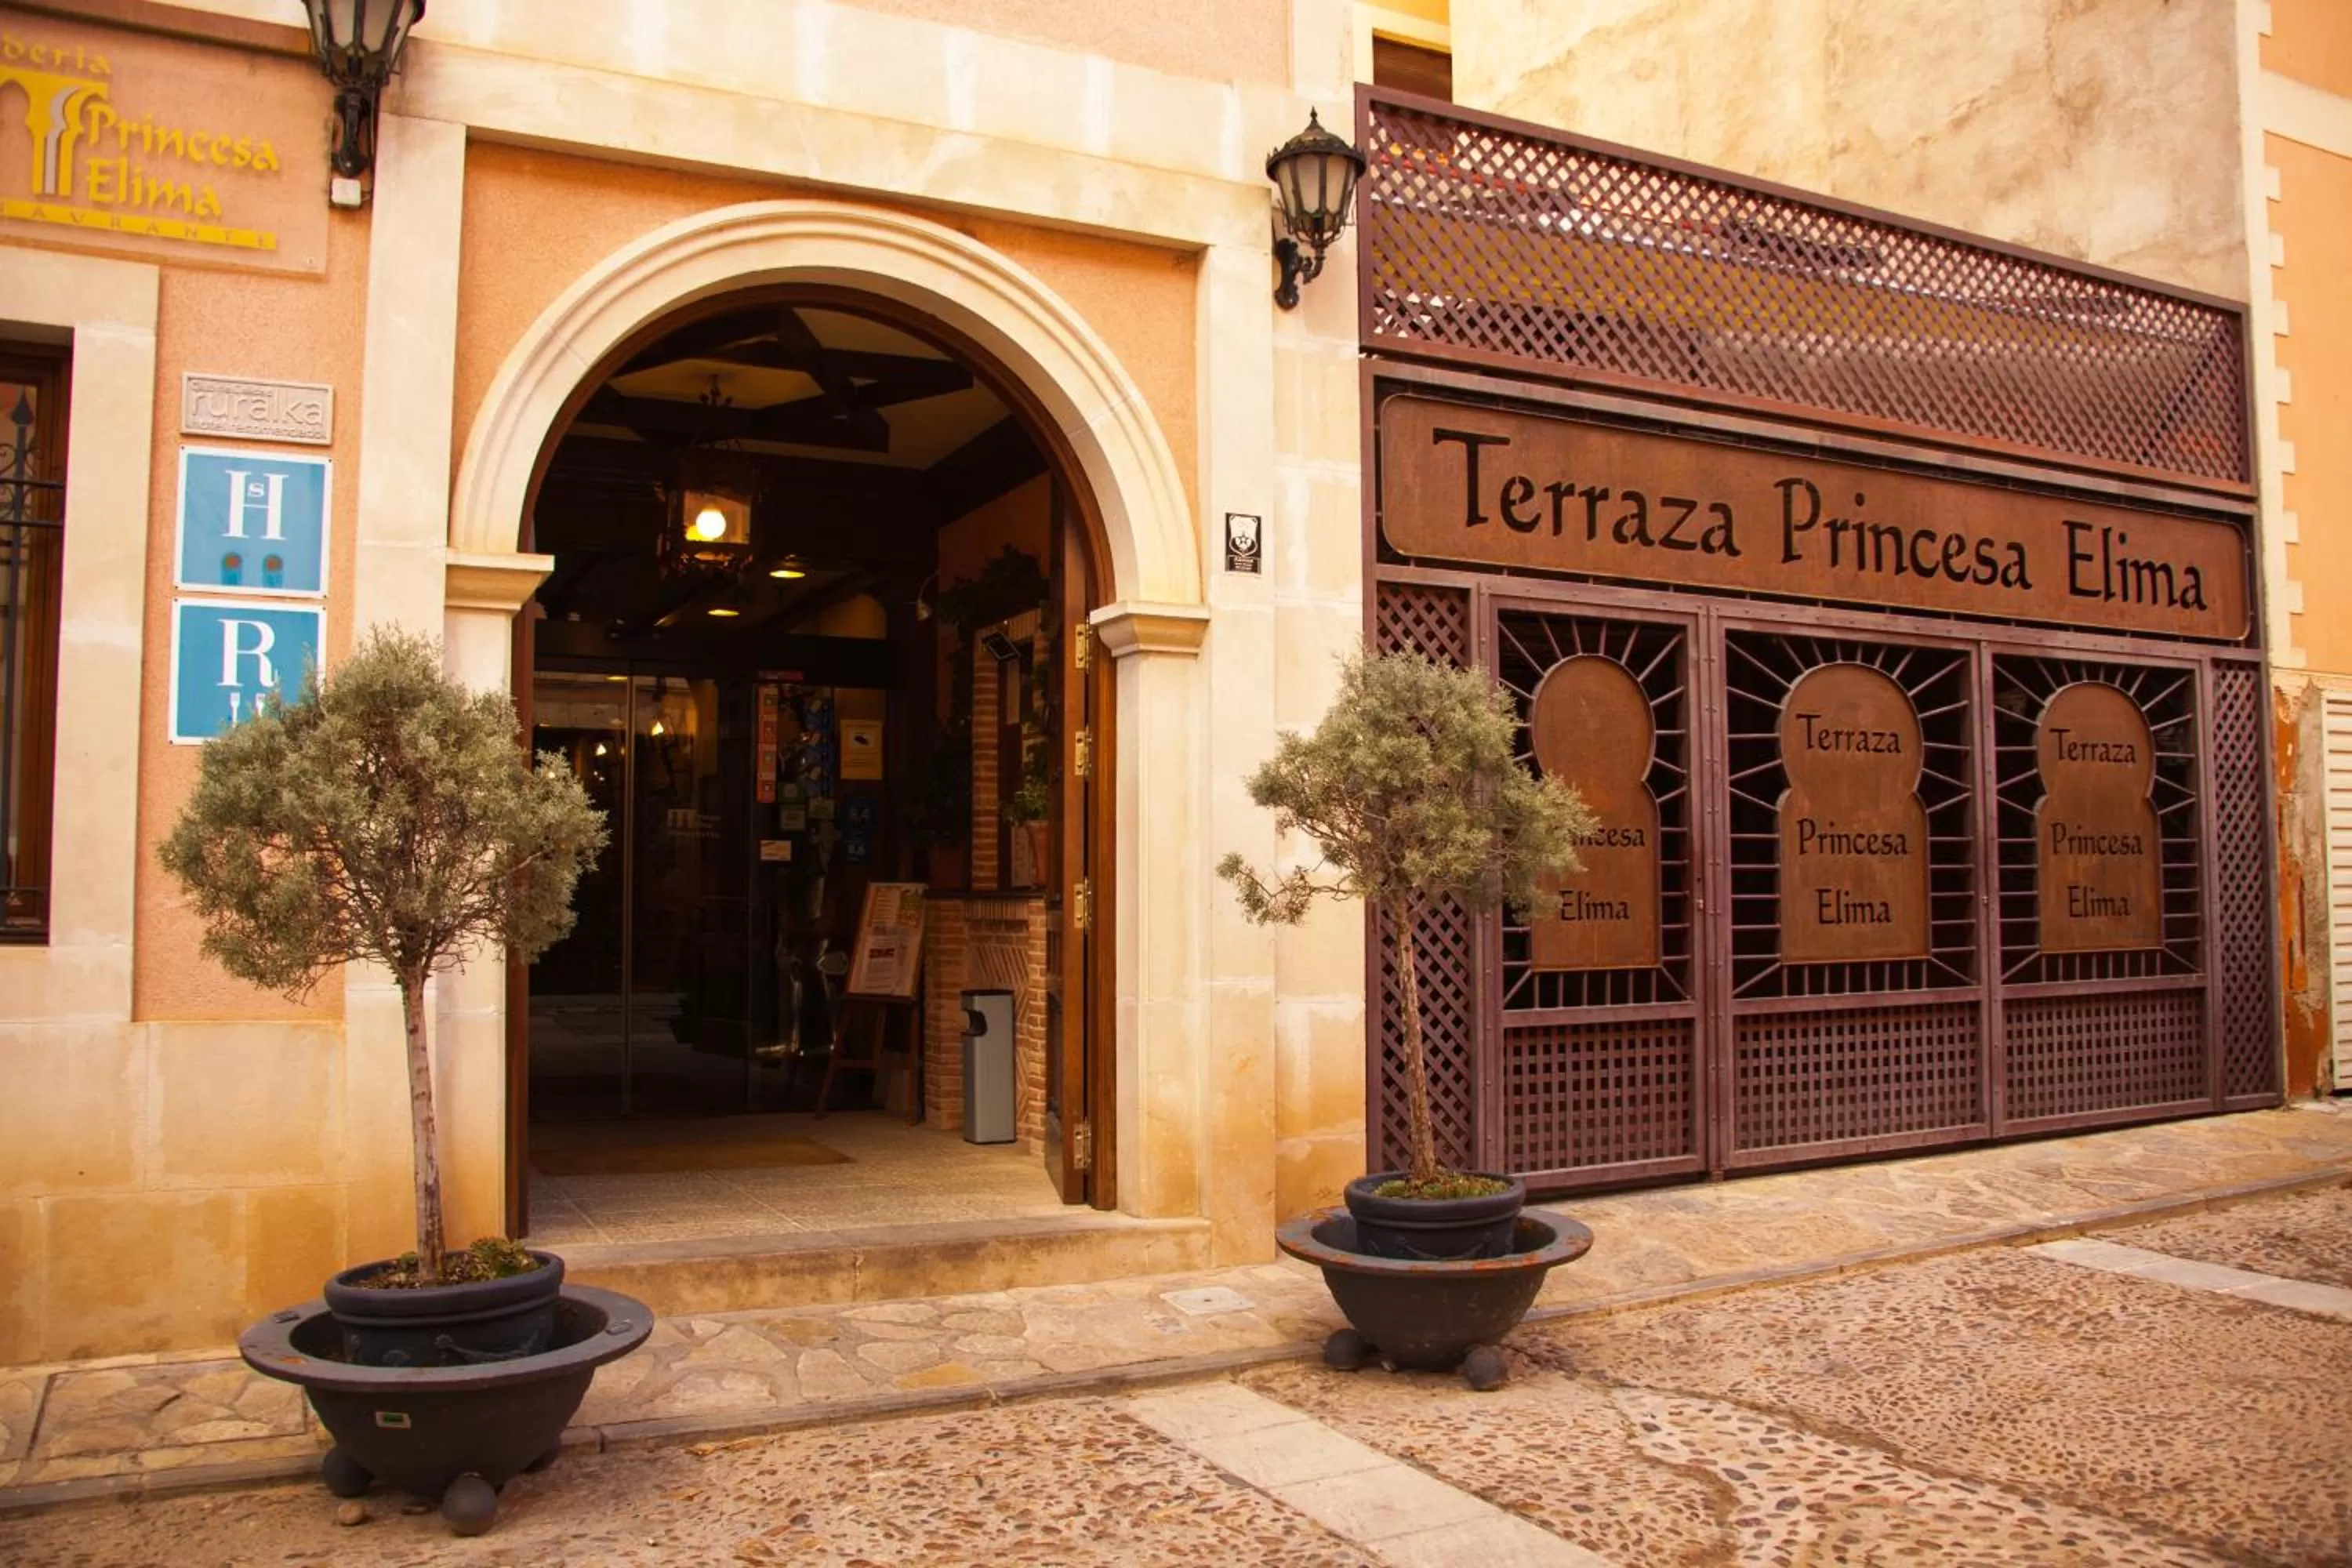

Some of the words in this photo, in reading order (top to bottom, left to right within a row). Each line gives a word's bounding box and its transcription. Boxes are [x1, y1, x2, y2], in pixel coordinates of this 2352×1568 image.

[86, 103, 279, 171] Princesa
[85, 156, 222, 216] Elima
[192, 387, 325, 426] ruralka
[1432, 426, 1742, 557] Terraza
[1773, 477, 2032, 590] Princesa
[2061, 520, 2208, 612] Elima
[216, 619, 276, 687] R
[1795, 713, 1902, 753] Terraza
[2049, 728, 2136, 764] Terraza
[1796, 818, 1907, 855] Princesa
[2050, 821, 2143, 855] Princesa
[1559, 889, 1630, 921] Elima
[1815, 888, 1891, 924] Elima
[2067, 884, 2132, 919] Elima
